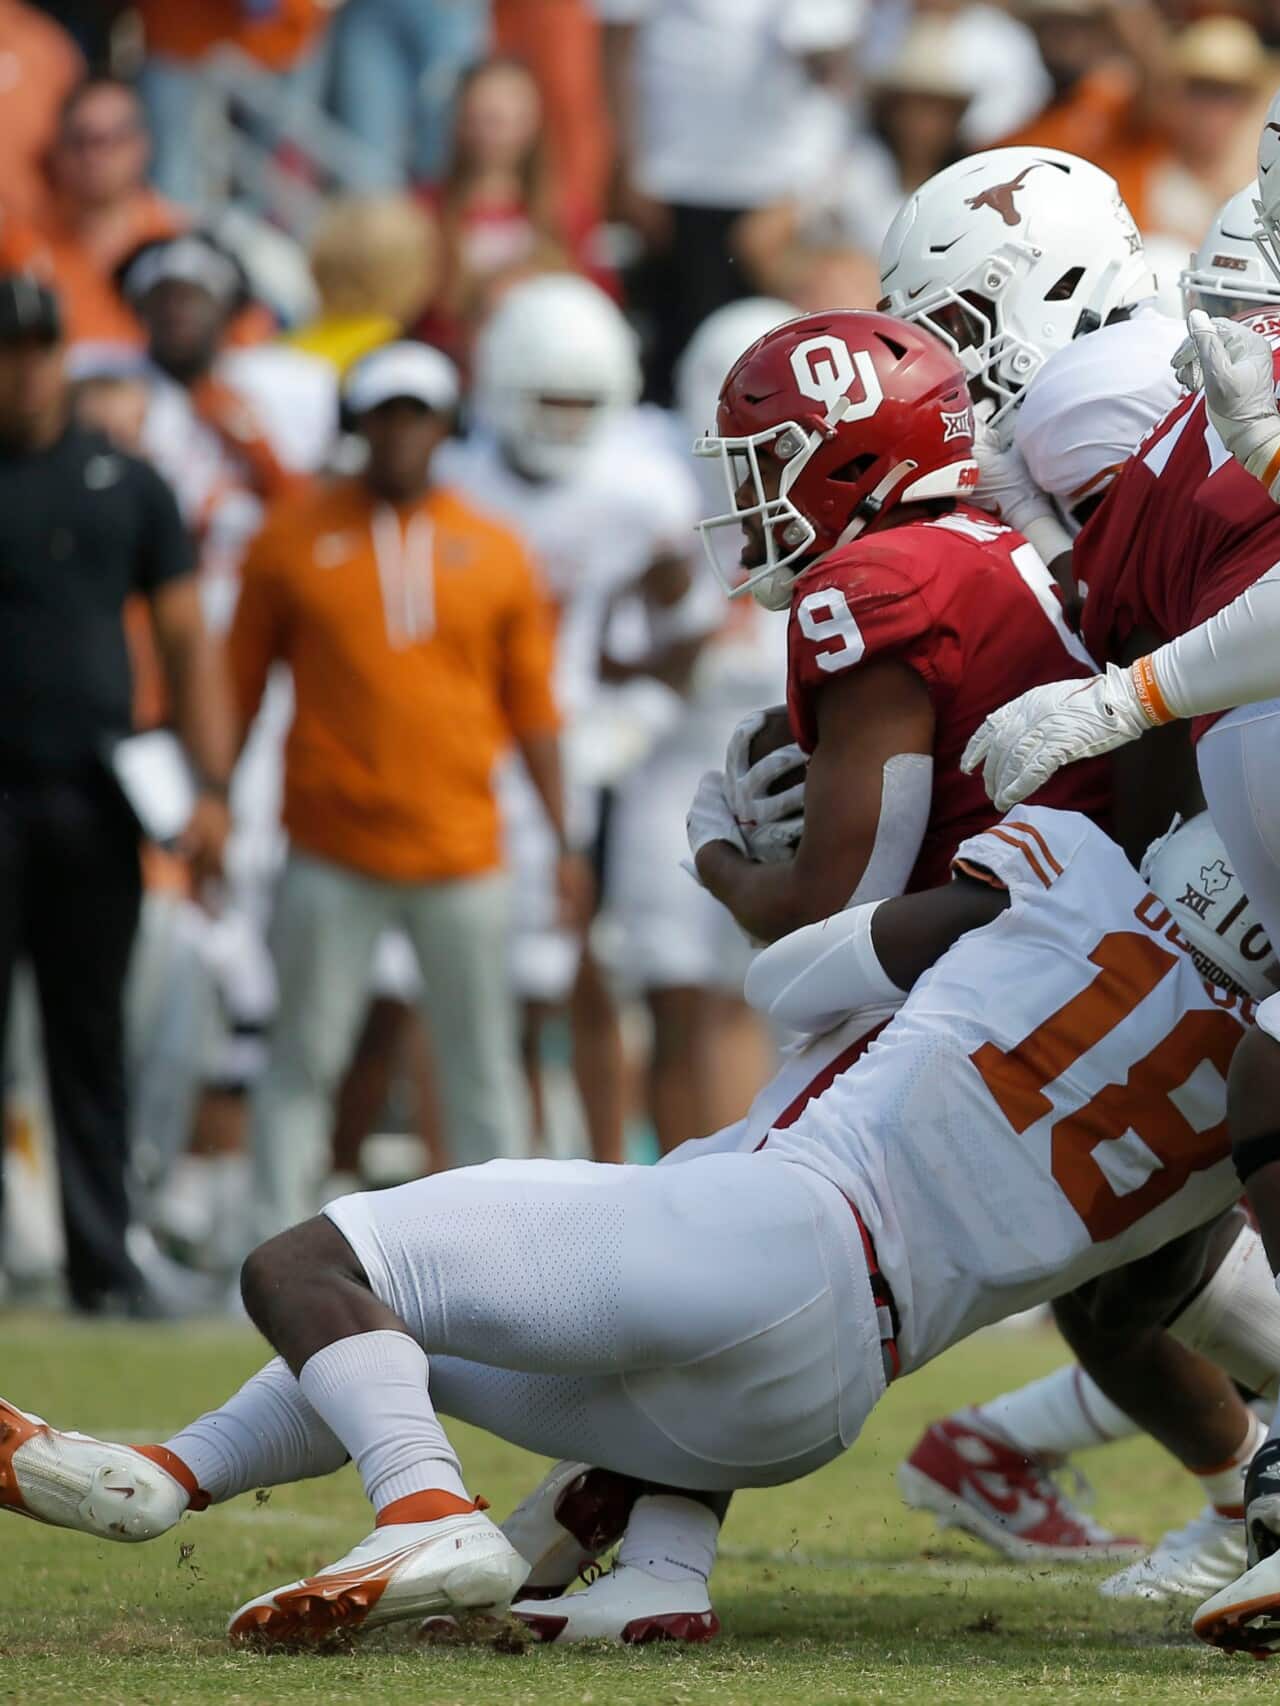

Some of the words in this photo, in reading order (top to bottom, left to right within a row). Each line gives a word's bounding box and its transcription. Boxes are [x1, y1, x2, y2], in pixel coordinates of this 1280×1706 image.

[790, 334, 884, 423] OU
[941, 410, 973, 441] XII
[798, 587, 866, 673] 9
[1176, 883, 1216, 921] XII
[970, 931, 1246, 1242] 18
